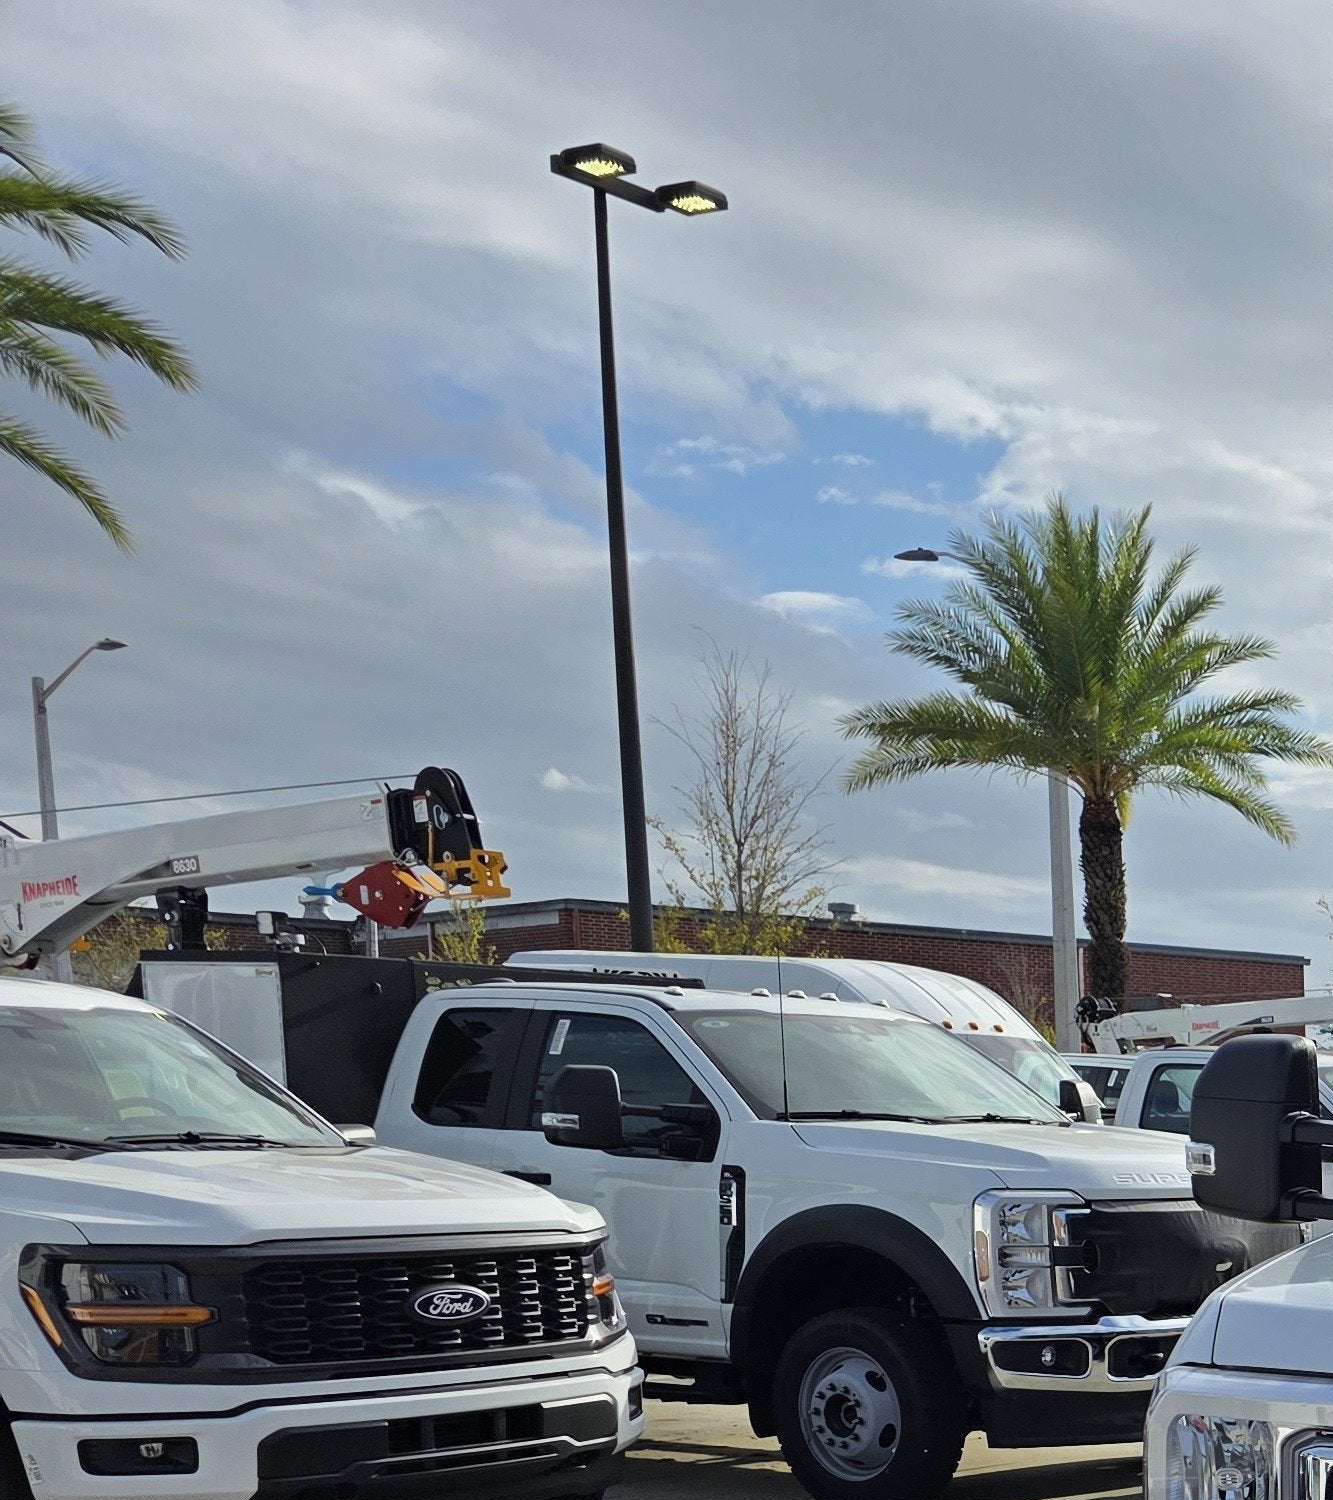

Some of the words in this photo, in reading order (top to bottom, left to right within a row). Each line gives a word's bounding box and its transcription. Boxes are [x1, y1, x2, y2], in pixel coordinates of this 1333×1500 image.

[172, 857, 197, 874] 8630
[21, 875, 80, 903] KNAPHEIDE
[1112, 1173, 1191, 1184] SUPE
[429, 1293, 474, 1315] Ford
